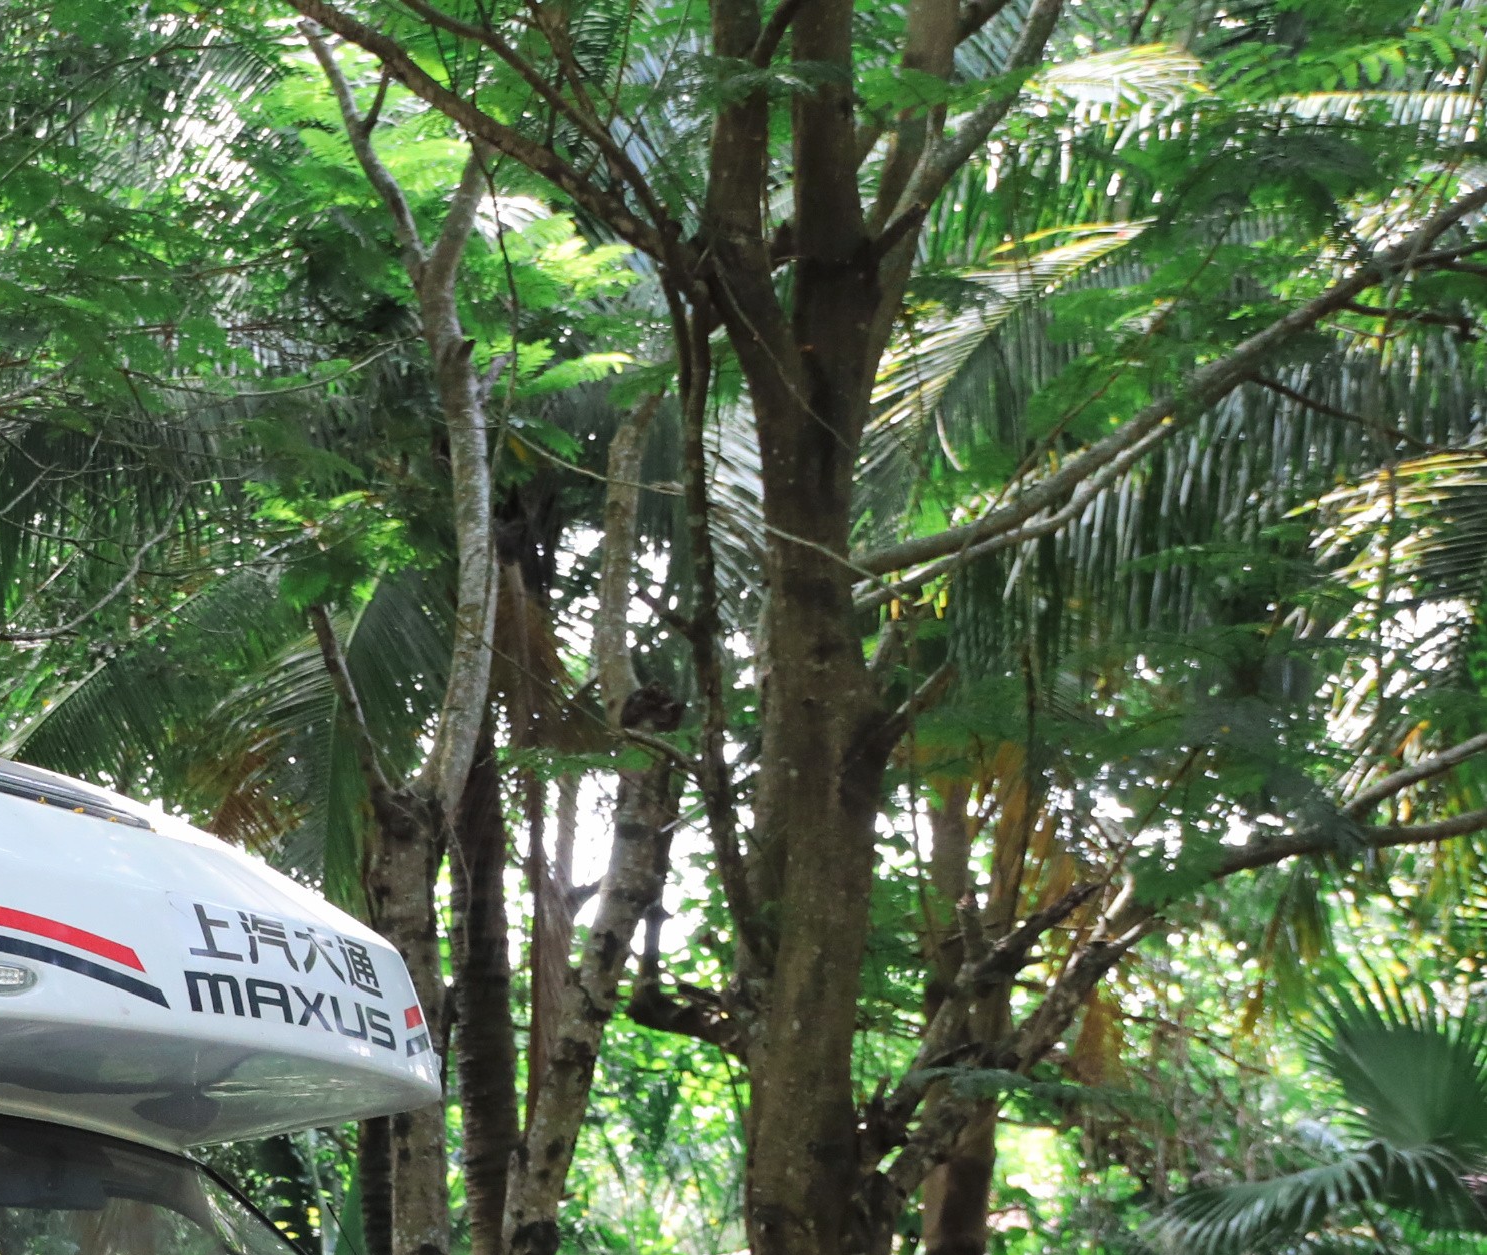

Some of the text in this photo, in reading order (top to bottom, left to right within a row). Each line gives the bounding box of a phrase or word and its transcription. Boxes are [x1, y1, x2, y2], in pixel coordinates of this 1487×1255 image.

[189, 903, 384, 999] 上汽大通
[184, 970, 397, 1051] MAXUS
